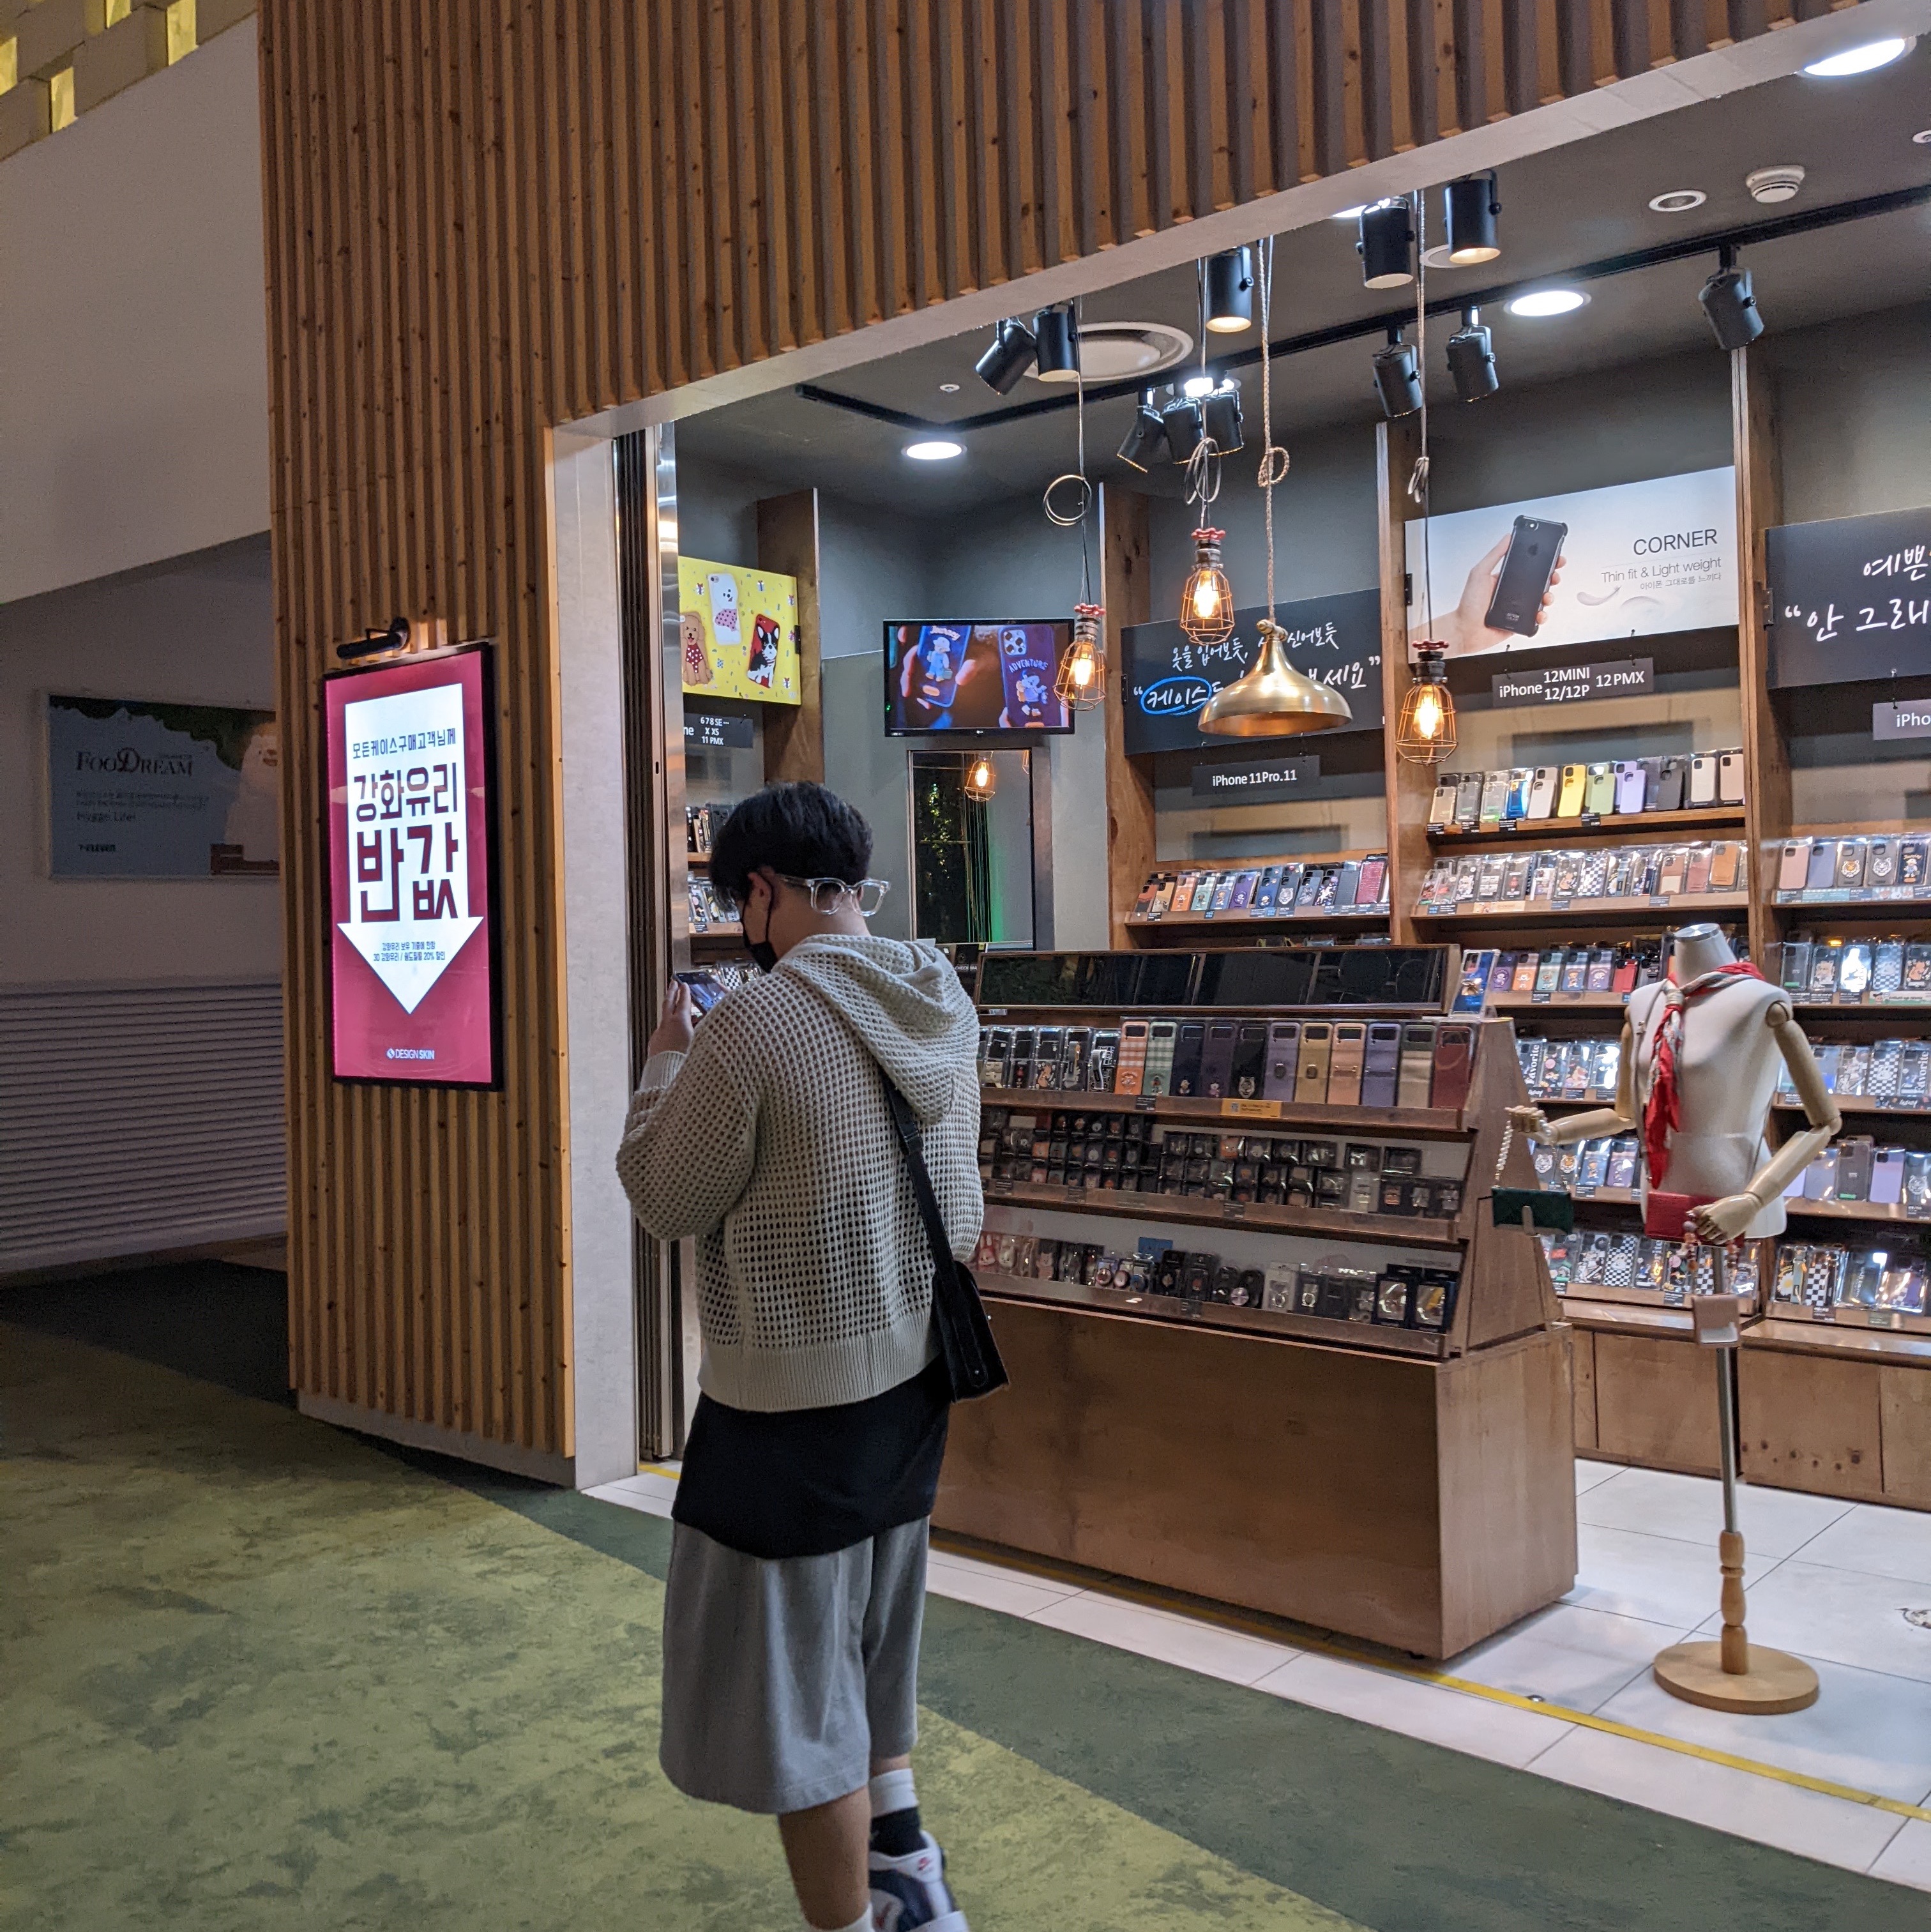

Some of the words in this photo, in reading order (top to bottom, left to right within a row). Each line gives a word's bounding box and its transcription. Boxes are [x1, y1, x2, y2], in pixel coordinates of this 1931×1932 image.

[1633, 528, 1718, 556] CORNER
[1601, 570, 1625, 583] Thin
[1628, 568, 1637, 579] fit
[1640, 567, 1649, 578] &
[1652, 563, 1680, 577] Light
[1683, 556, 1722, 572] weight
[1863, 545, 1928, 581] 예쁜
[1640, 580, 1663, 590] 아이폰
[1665, 575, 1695, 587] 그대로를
[1698, 572, 1722, 582] 느끼다
[1172, 646, 1193, 672] 옷을
[1287, 621, 1340, 650] 신어보듯
[1008, 658, 1049, 673] ADVENTURE
[1499, 684, 1543, 698] iPhone
[1543, 667, 1591, 683] 12MINI
[1544, 685, 1591, 701] 12/12P
[683, 726, 694, 736] ne
[704, 727, 710, 735] X
[711, 727, 720, 736] XS
[701, 736, 709, 744] 11
[1212, 774, 1248, 787] iPhone
[354, 762, 458, 823] 강화유리
[356, 823, 459, 923] 반값
[382, 942, 400, 951] 강화유리
[381, 952, 399, 962] 강화유리
[423, 952, 435, 961] 20%
